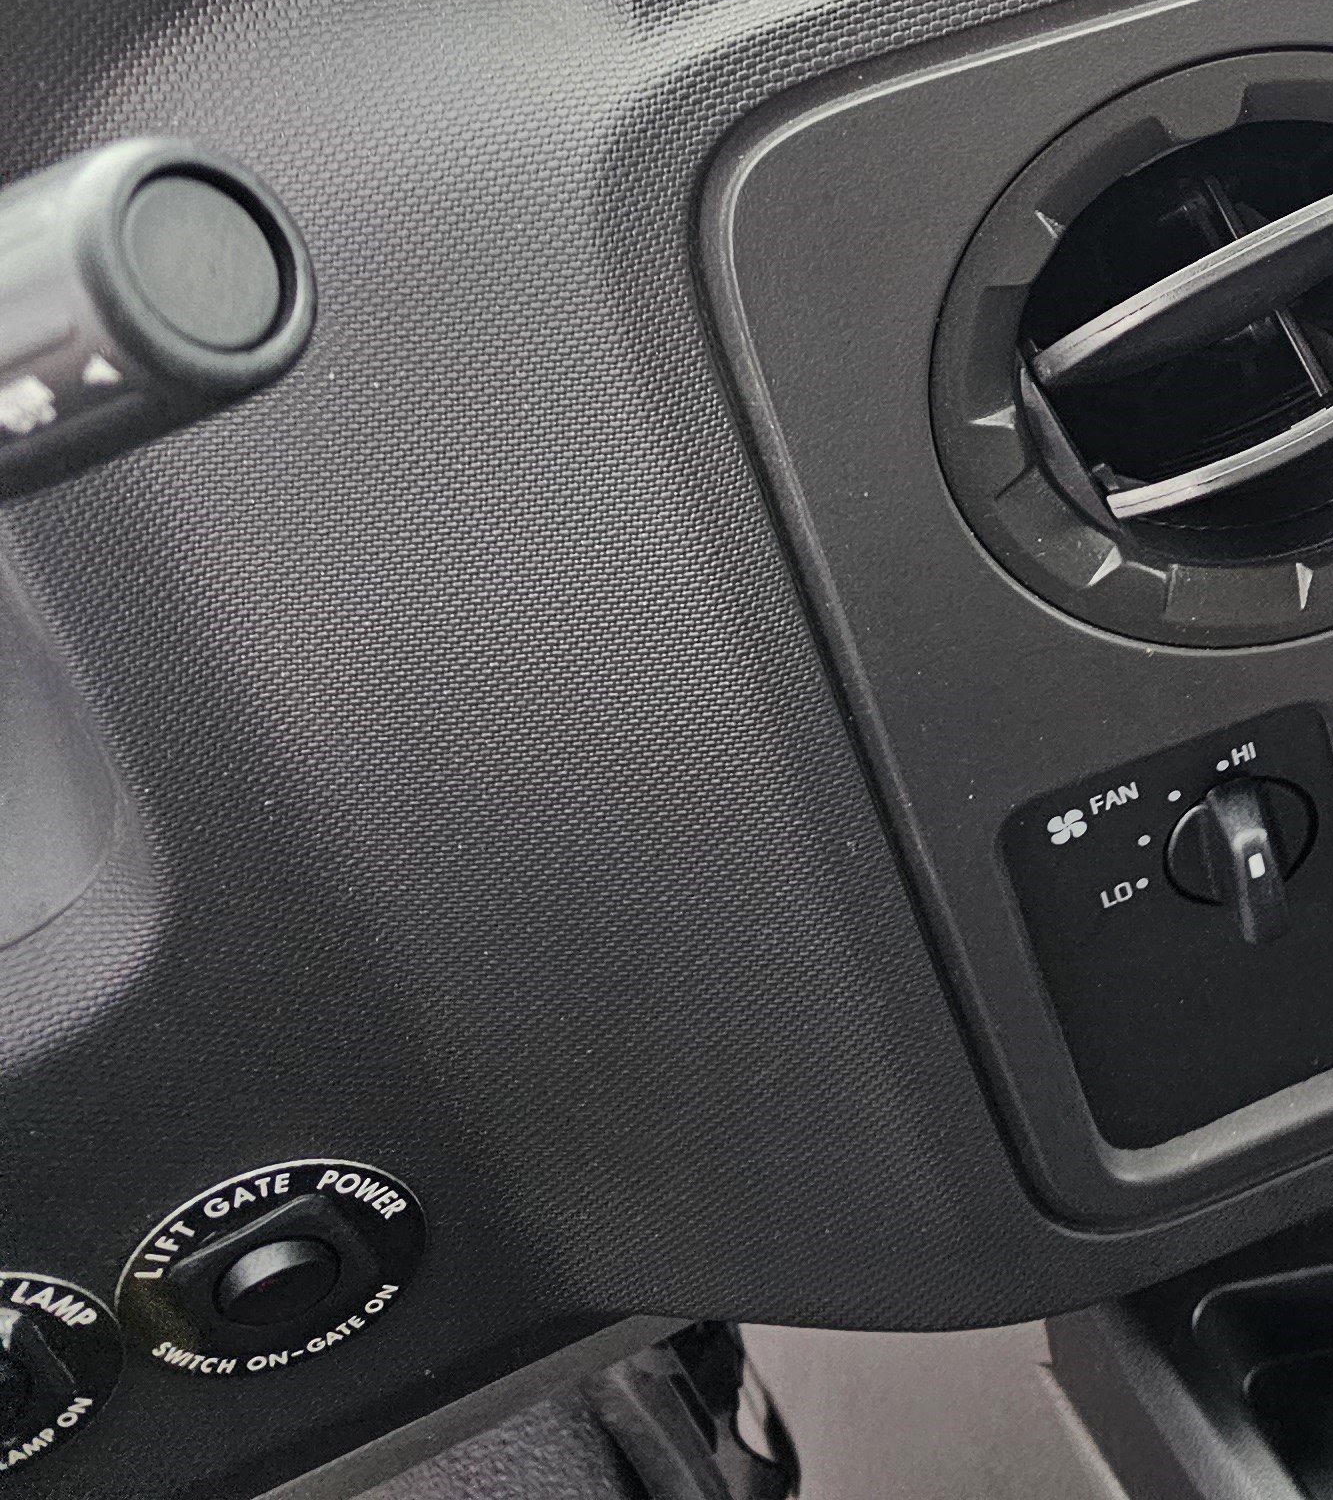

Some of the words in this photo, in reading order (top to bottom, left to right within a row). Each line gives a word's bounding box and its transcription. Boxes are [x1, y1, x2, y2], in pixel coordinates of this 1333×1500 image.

[1231, 741, 1257, 766] HI
[1089, 781, 1139, 815] FAN
[1100, 881, 1133, 908] LO
[134, 1220, 195, 1280] LIFT
[203, 1173, 290, 1218] GATE
[316, 1169, 407, 1220] POWER
[10, 1280, 98, 1327] LAMP
[152, 1341, 236, 1374] SWITCH
[365, 1284, 399, 1314] ON
[57, 1397, 93, 1428] ON
